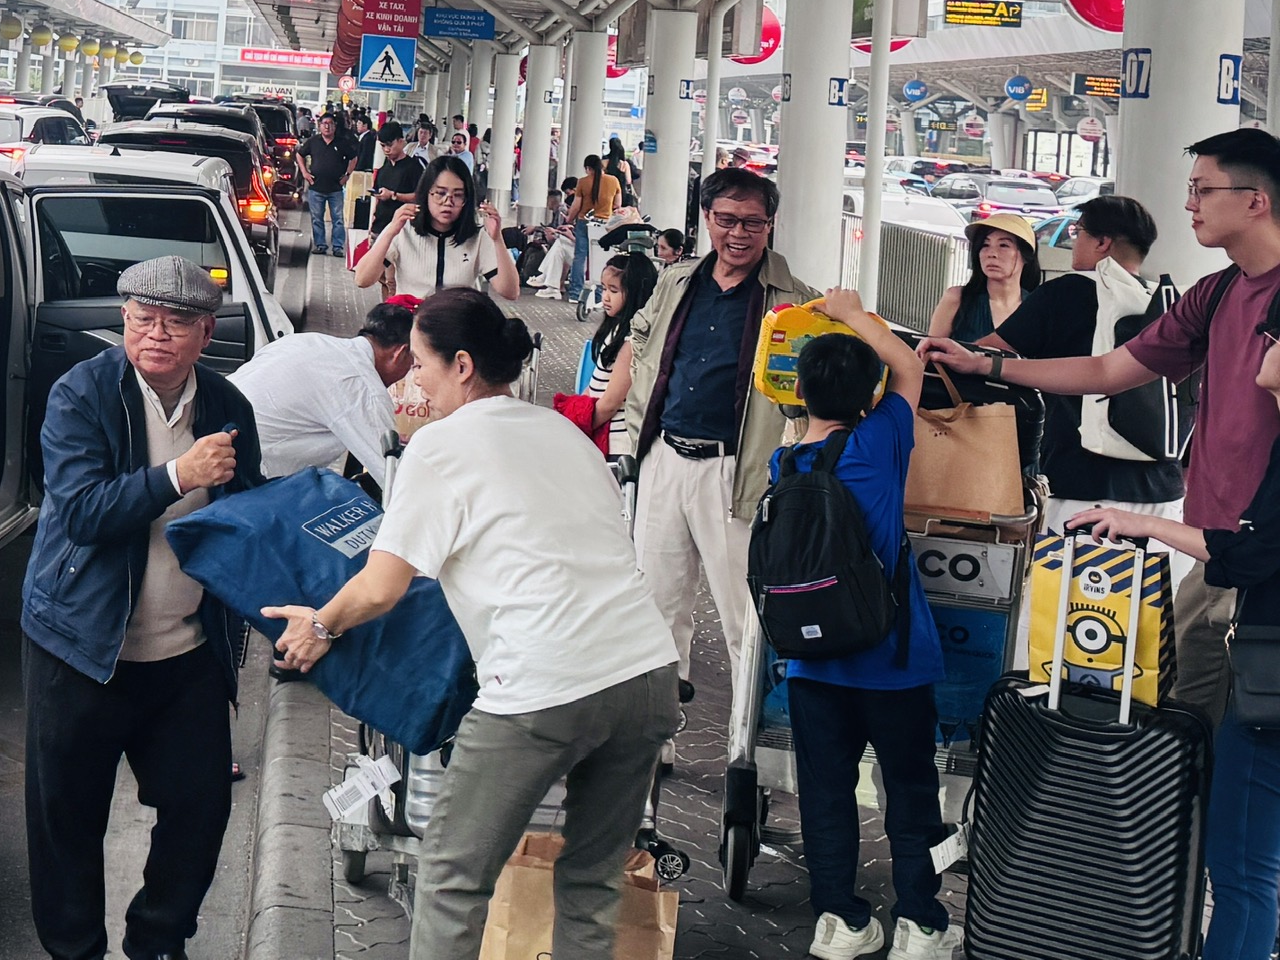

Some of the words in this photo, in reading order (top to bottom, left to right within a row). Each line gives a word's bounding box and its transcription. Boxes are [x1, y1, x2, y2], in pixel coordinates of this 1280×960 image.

[378, 1, 388, 9] XE
[389, 2, 406, 12] TAXI,
[994, 2, 1008, 17] A
[365, 12, 375, 20] XE
[375, 13, 393, 21] KINH
[393, 14, 418, 23] DOANH
[1008, 86, 1025, 94] VIB
[314, 506, 369, 538] WALKER
[344, 525, 378, 550] DUTY
[1083, 583, 1106, 595] IRVINS
